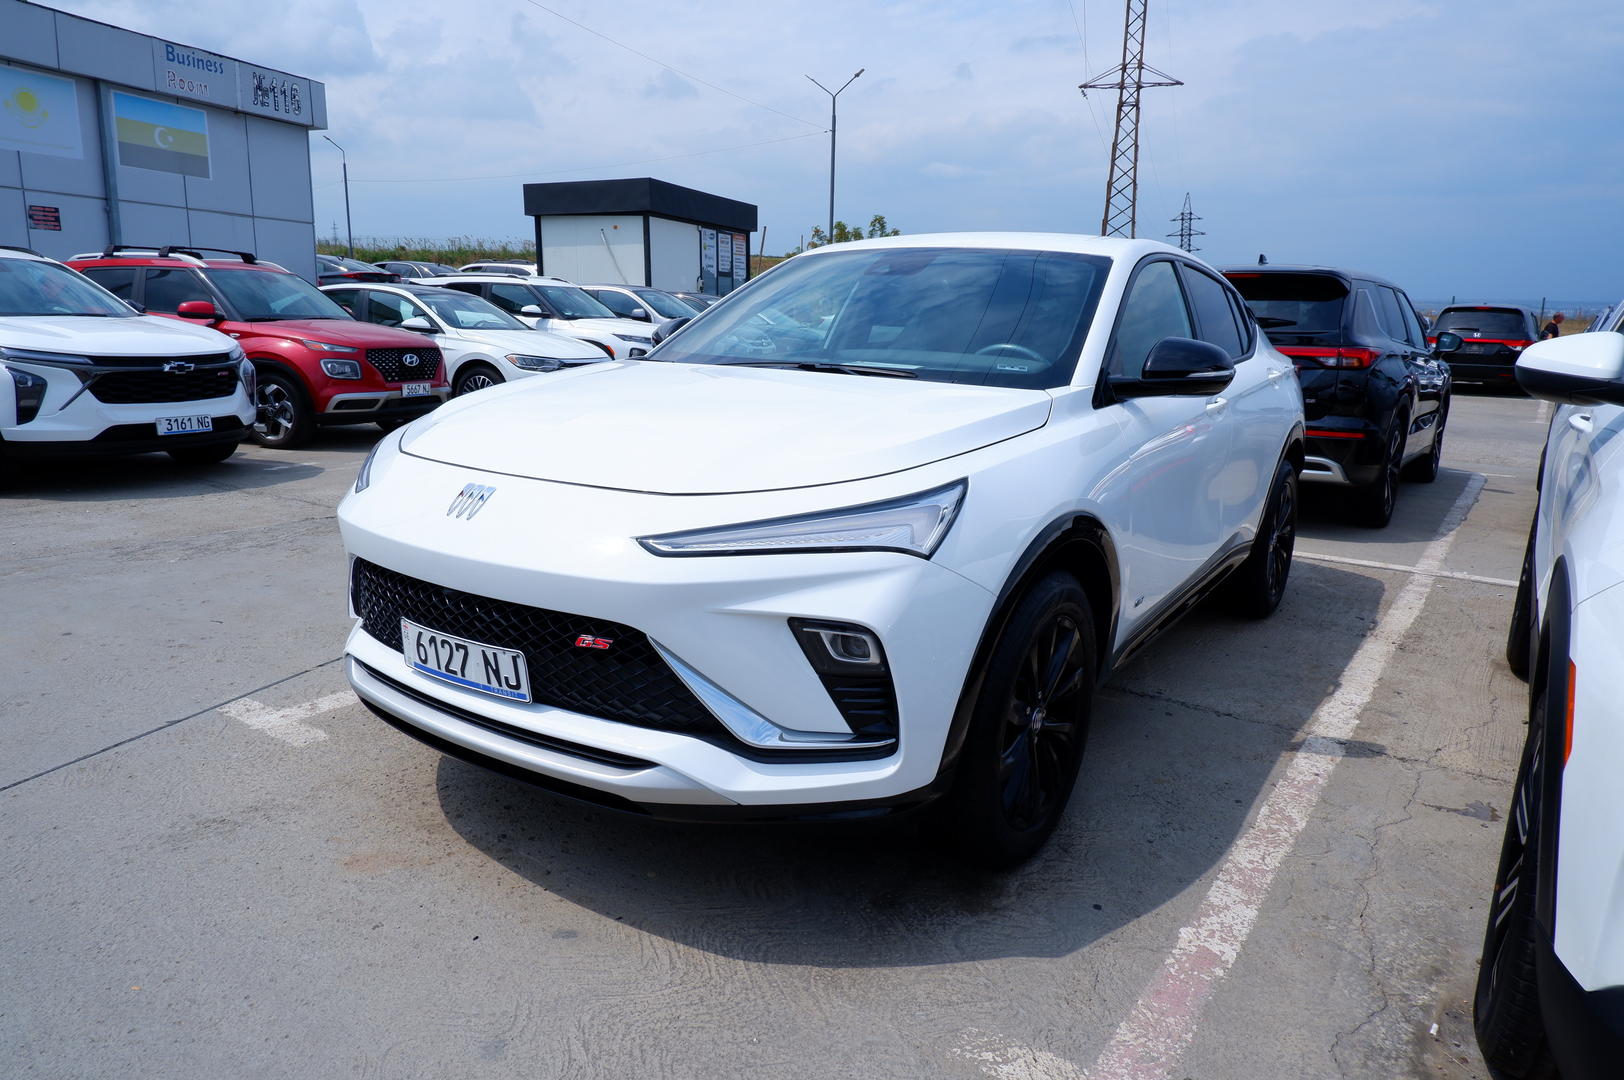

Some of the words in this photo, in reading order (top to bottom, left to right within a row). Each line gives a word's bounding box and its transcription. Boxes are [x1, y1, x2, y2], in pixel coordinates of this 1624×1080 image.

[165, 44, 224, 75] Business
[167, 70, 209, 97] Room
[165, 417, 193, 432] 3161
[196, 415, 210, 429] NG
[574, 634, 614, 650] GS
[416, 630, 469, 678] 6127
[481, 648, 522, 691] NJ
